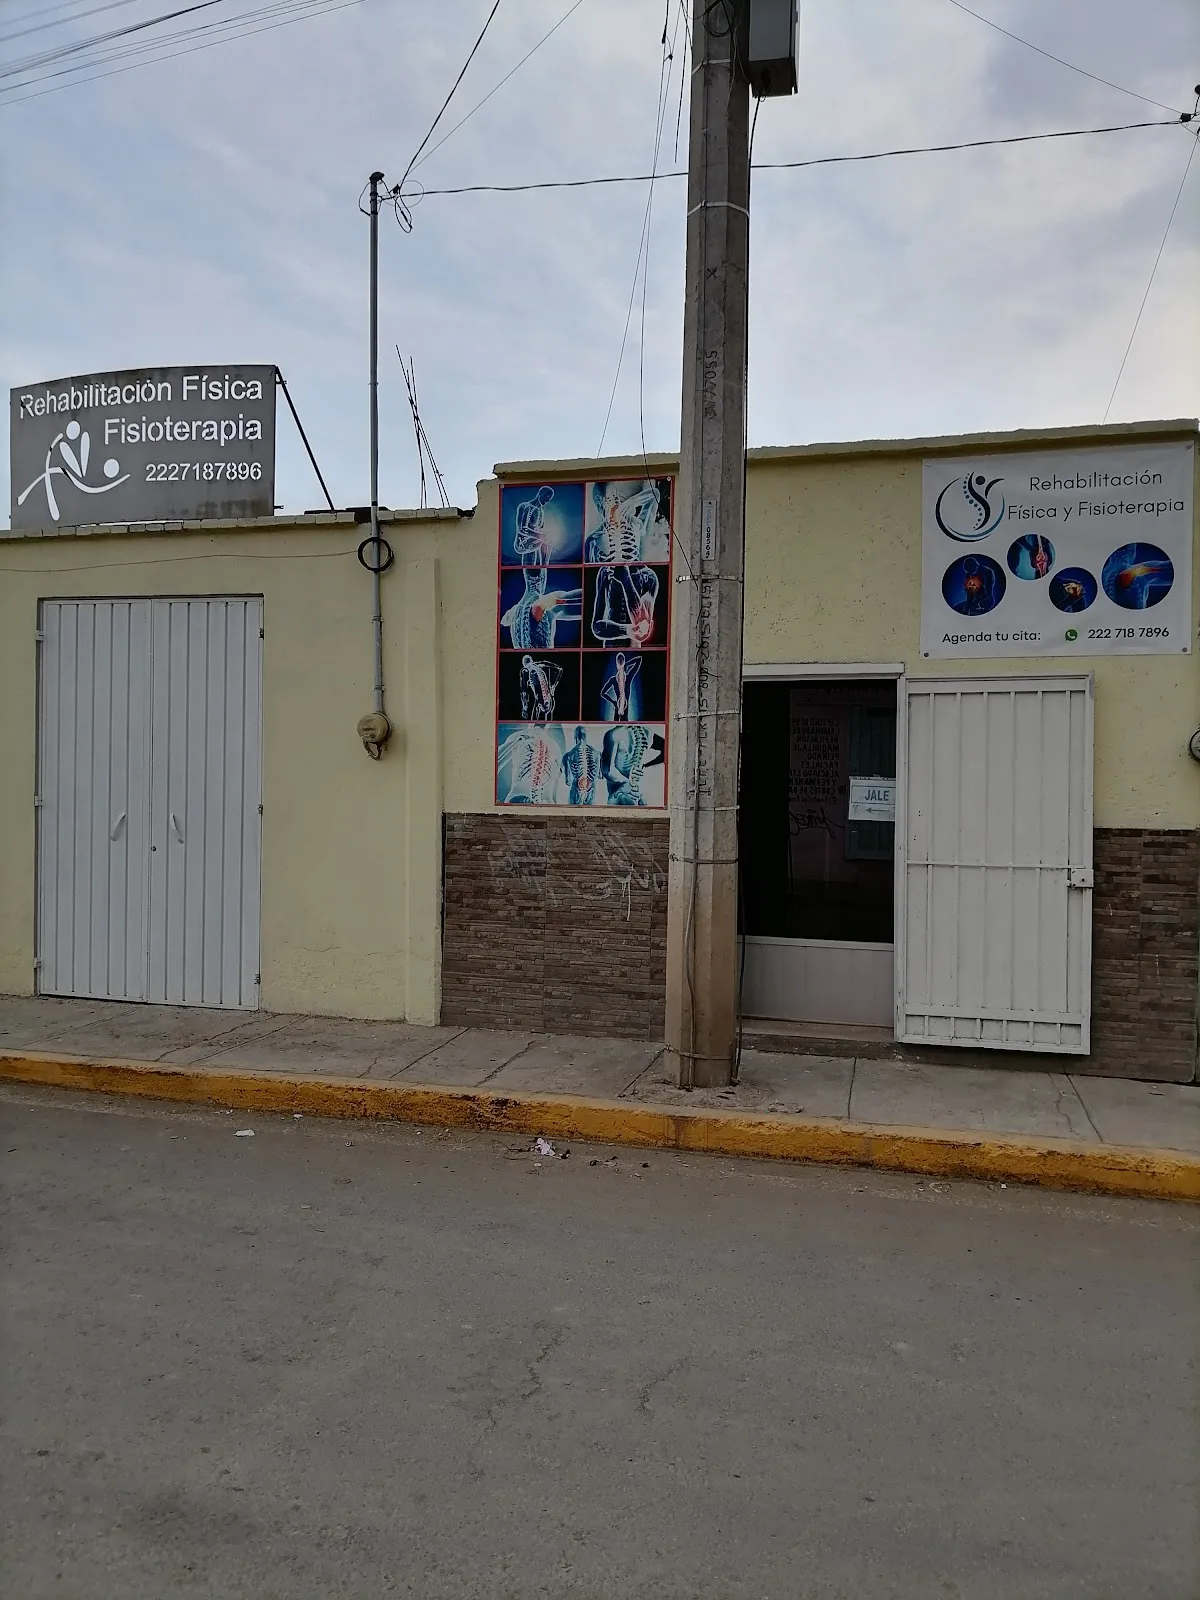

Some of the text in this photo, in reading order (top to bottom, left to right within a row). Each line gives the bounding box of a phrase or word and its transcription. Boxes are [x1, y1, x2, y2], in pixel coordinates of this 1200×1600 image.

[20, 375, 263, 419] Rehabilitación Física
[104, 413, 262, 446] Fisioterapia
[145, 462, 262, 482] 2227187896
[1029, 470, 1162, 491] Rehabilitación
[1008, 499, 1184, 521] Física y Fisioterapia
[942, 630, 1041, 645] Agenda tu cita:
[1087, 627, 1169, 639] 222 718 7896
[864, 789, 890, 801] JALE
